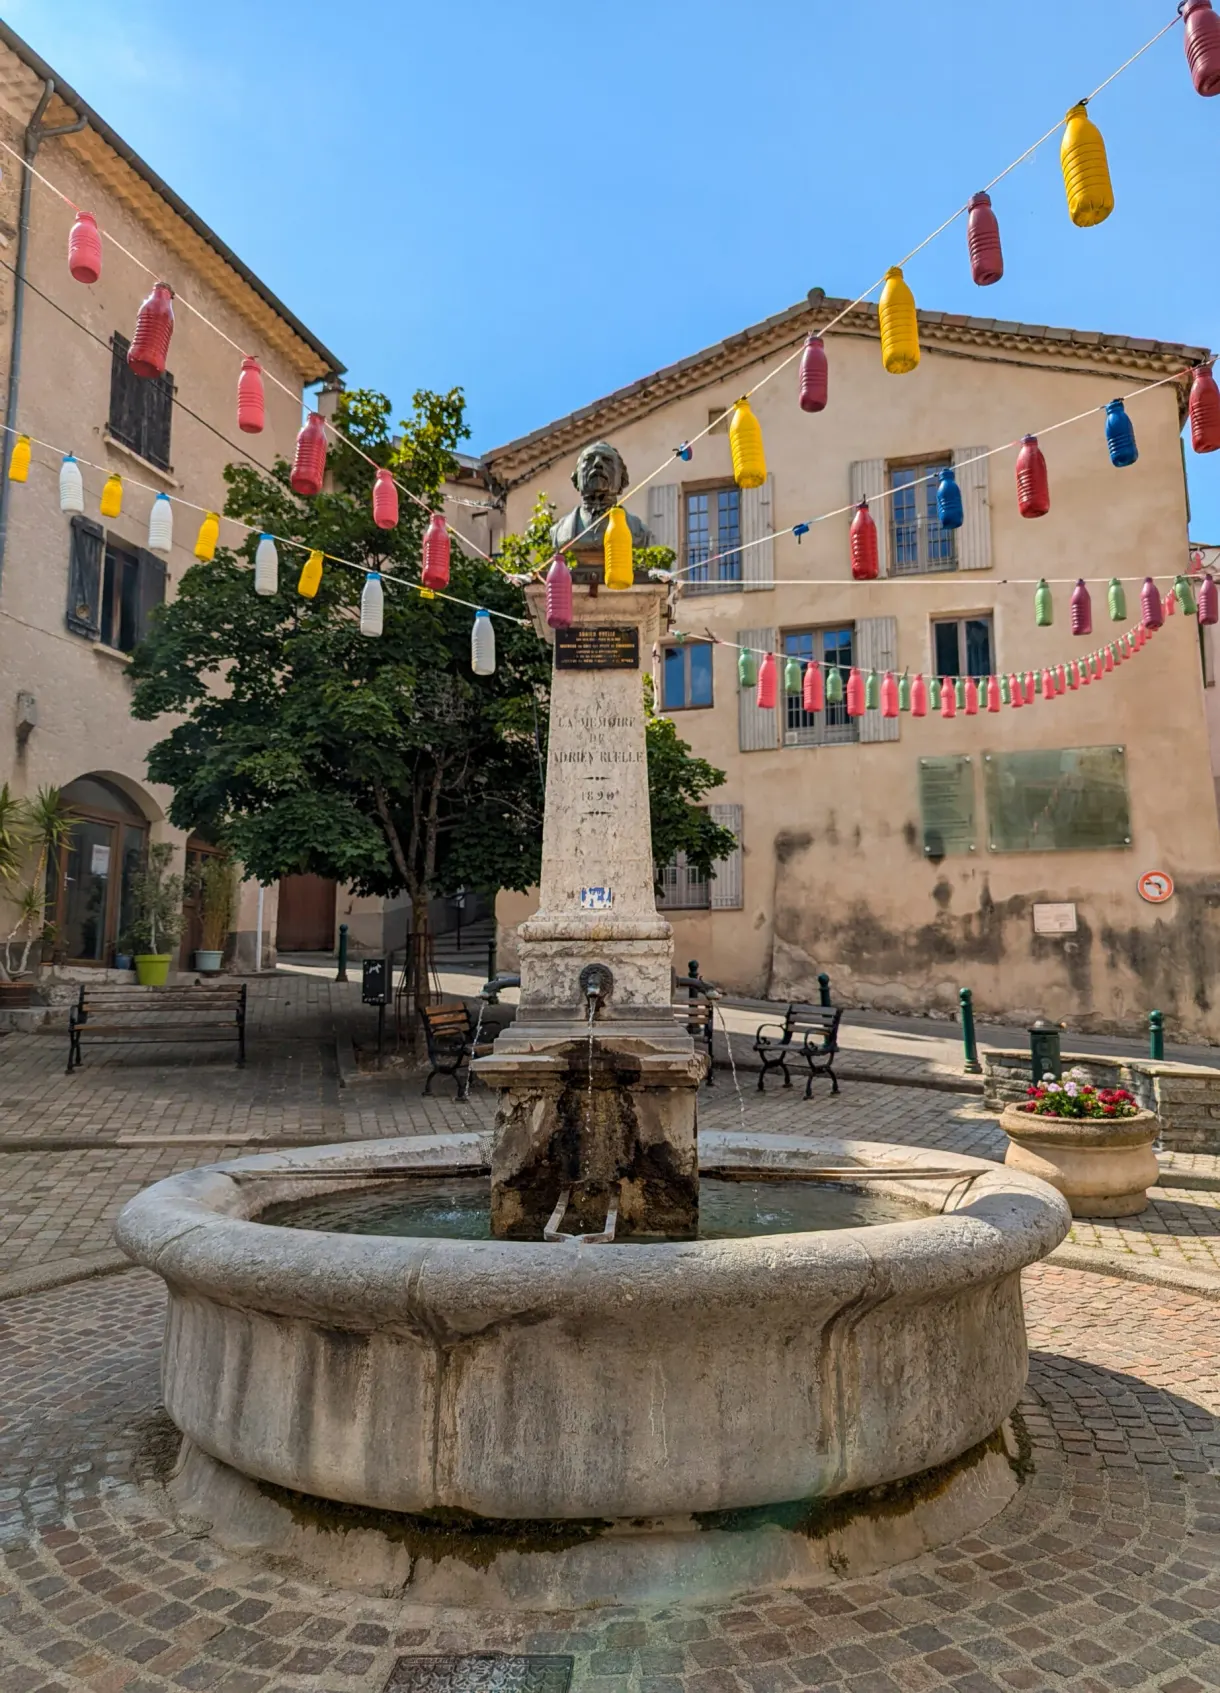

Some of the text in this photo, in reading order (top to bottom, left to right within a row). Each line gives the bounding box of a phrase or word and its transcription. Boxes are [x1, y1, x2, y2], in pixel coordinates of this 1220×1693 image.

[557, 717, 573, 728] LA
[554, 751, 643, 763] ADRIEN RUELLE
